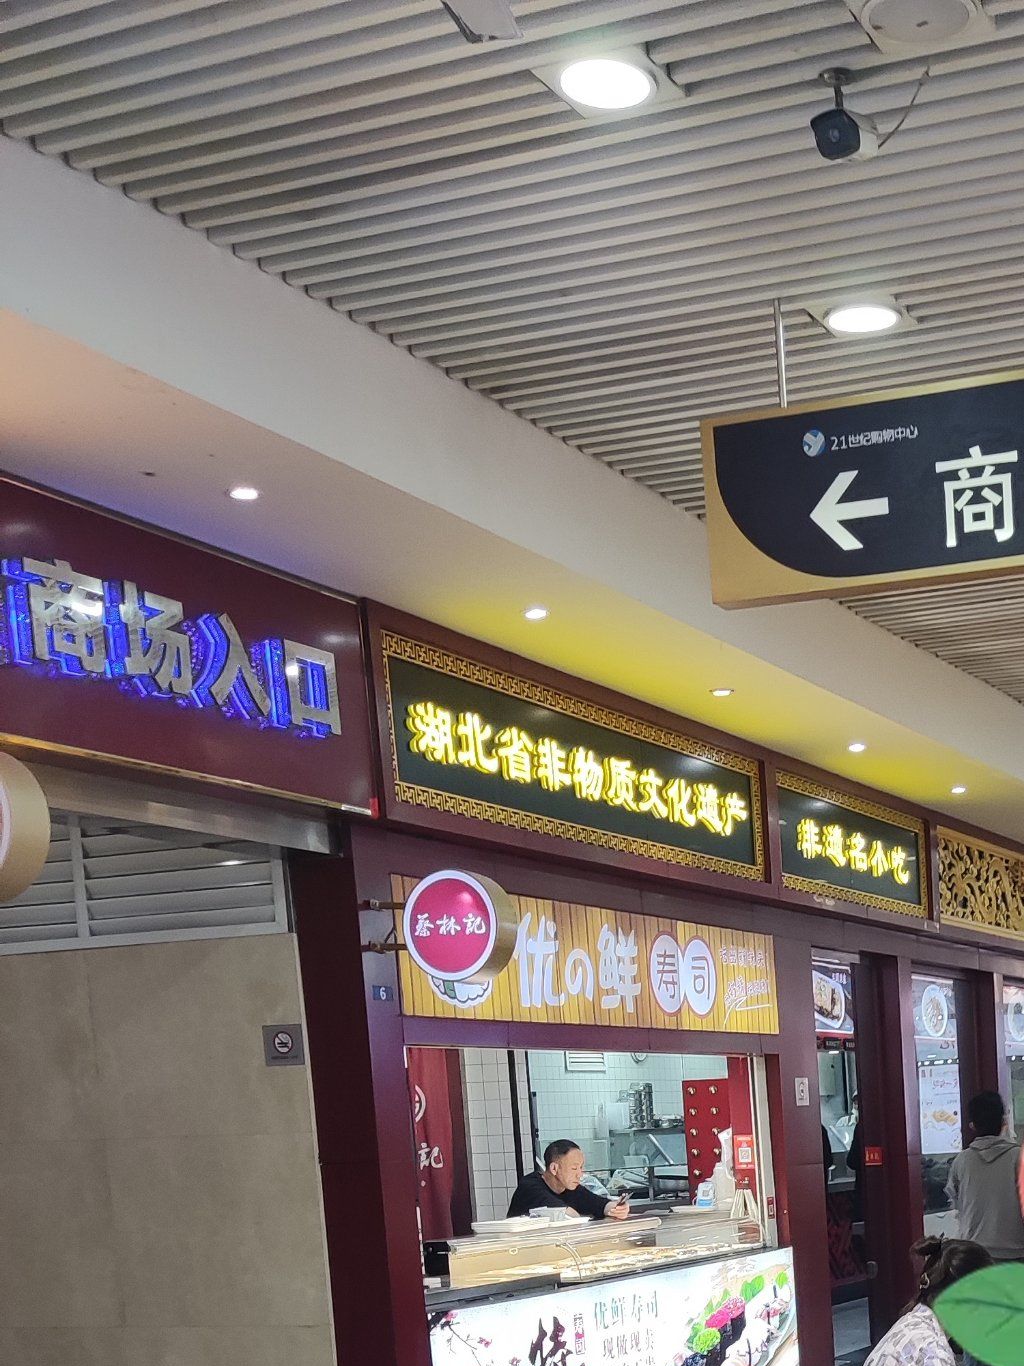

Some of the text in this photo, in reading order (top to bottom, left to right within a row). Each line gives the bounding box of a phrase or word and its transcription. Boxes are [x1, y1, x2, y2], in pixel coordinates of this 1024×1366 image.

[830, 425, 918, 450] 21世纪购物中心
[5, 557, 342, 737] 商场入口
[406, 701, 747, 836] 湖北省非物质文化遗产
[797, 818, 909, 885] 非遗名小吃
[380, 986, 387, 1000] 6
[594, 1290, 659, 1331] 优鲜寿司
[602, 1329, 657, 1360] 现做现卖
